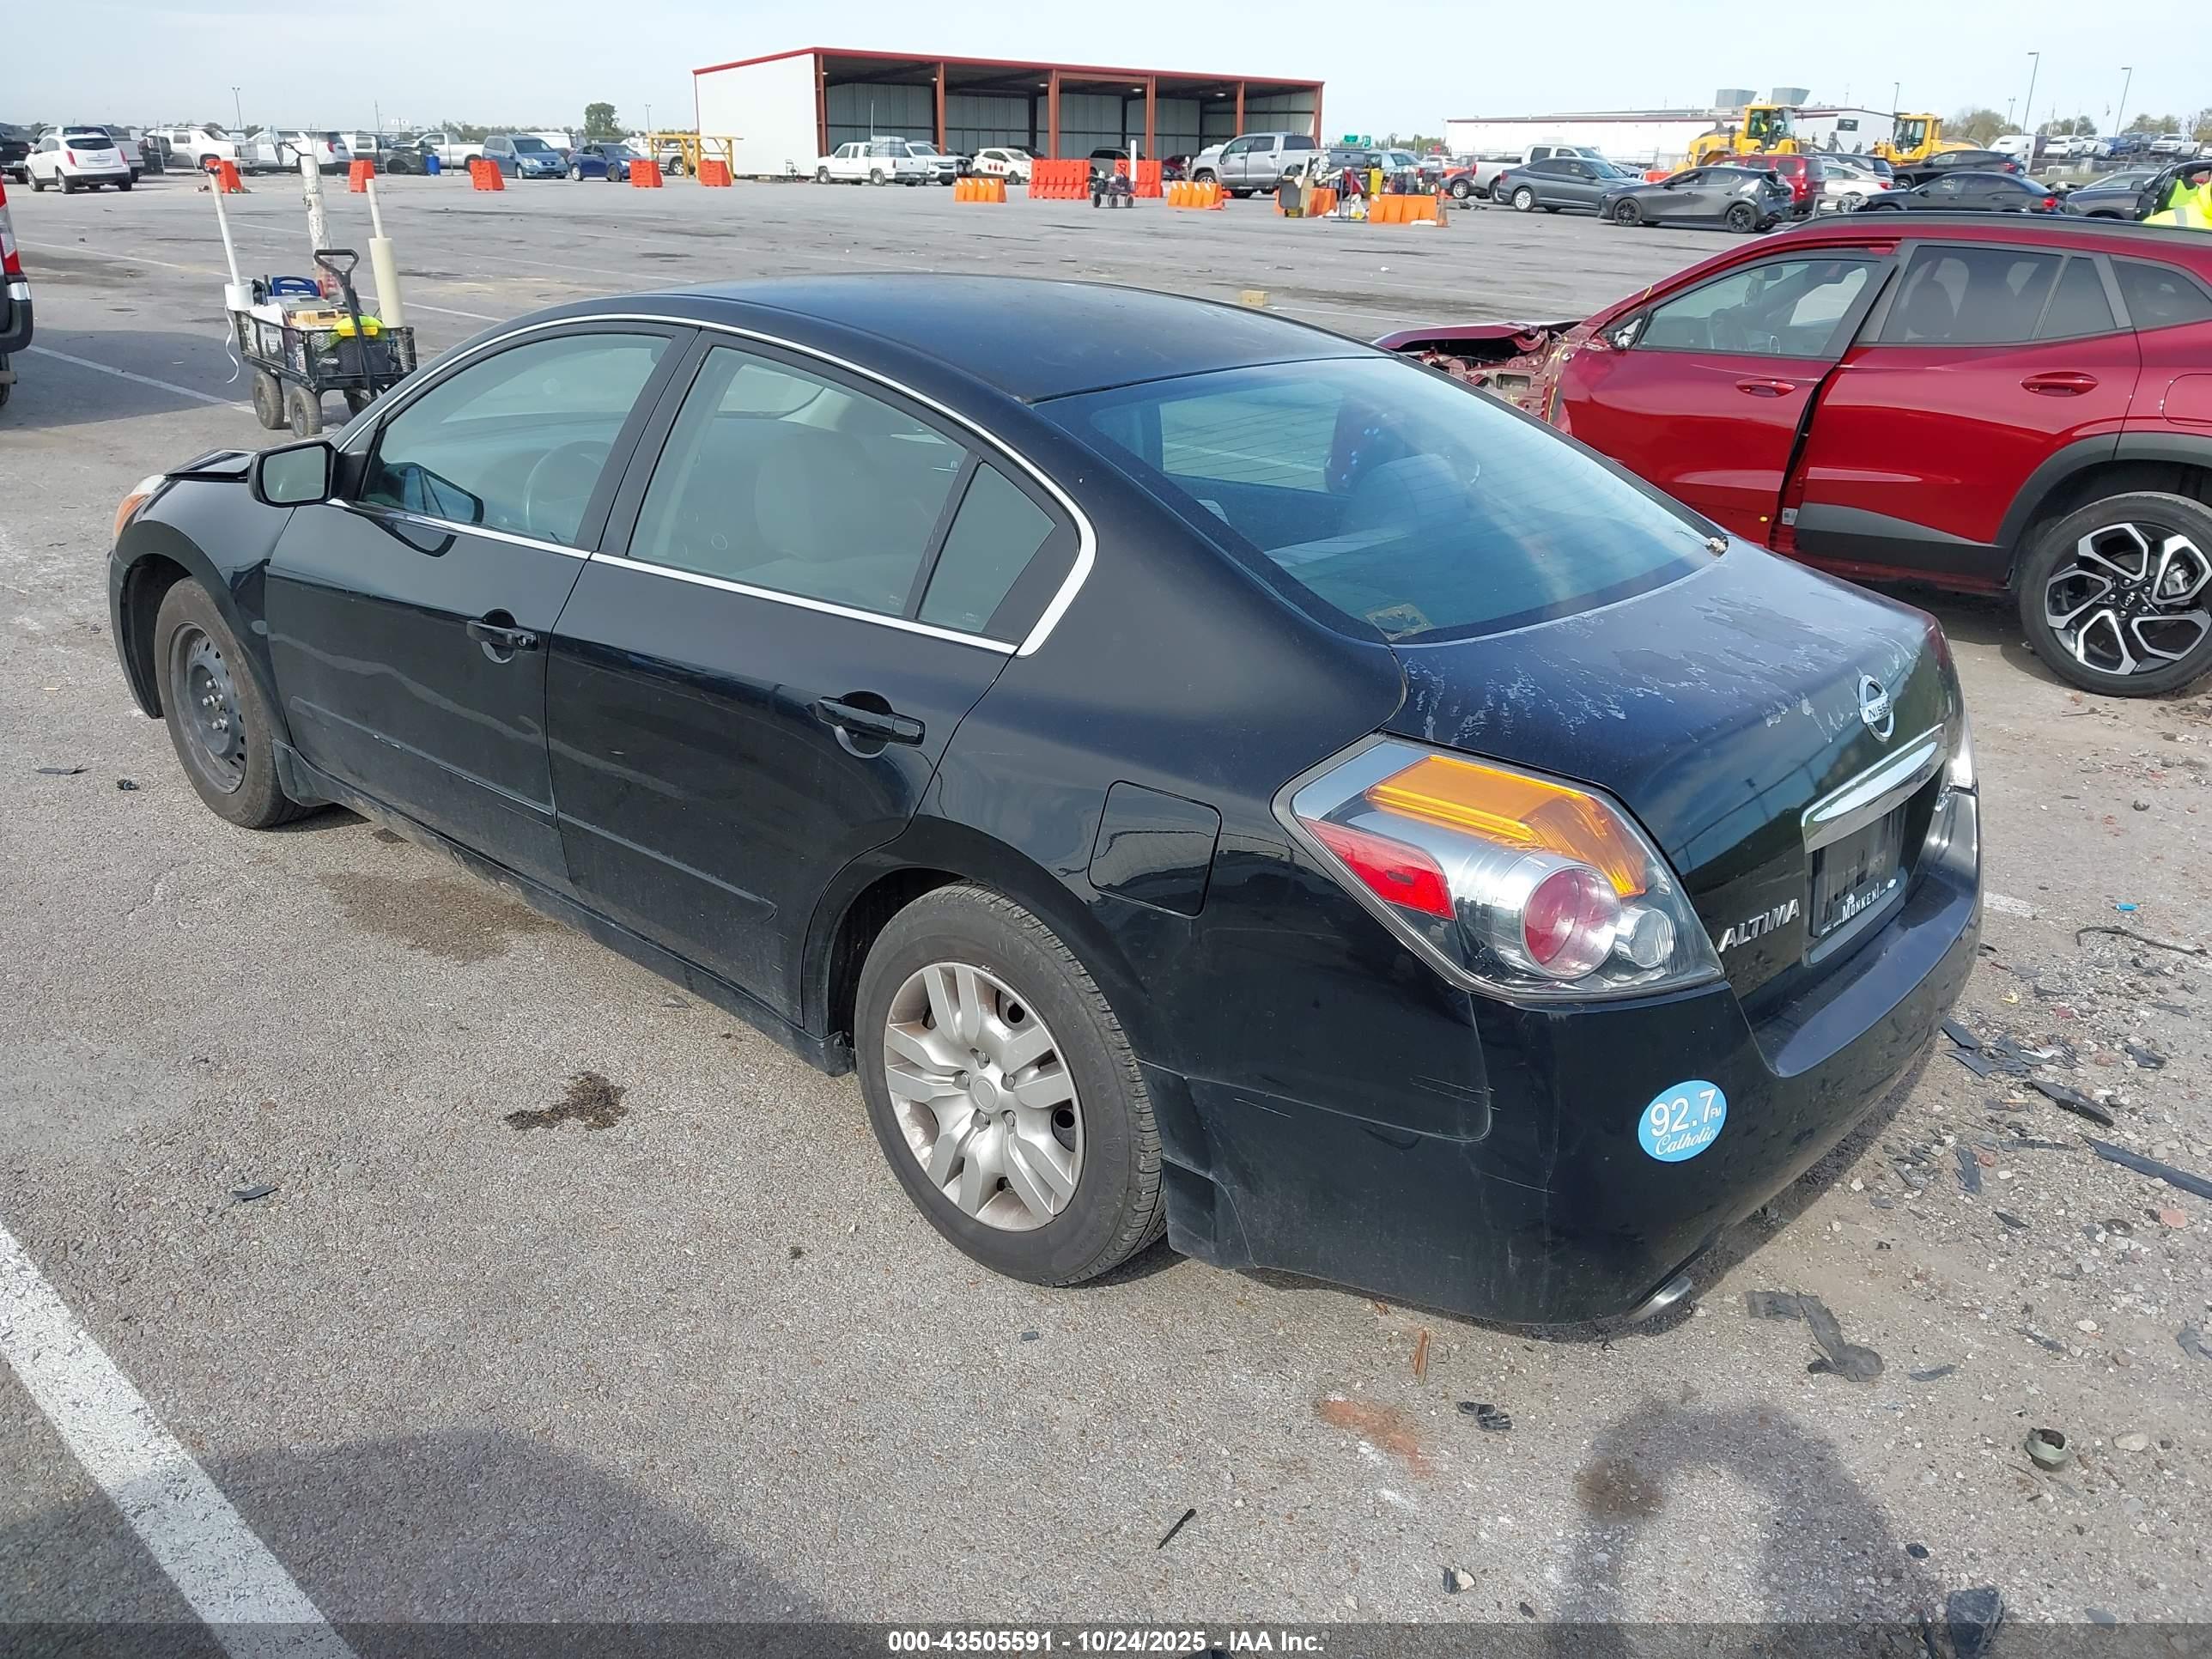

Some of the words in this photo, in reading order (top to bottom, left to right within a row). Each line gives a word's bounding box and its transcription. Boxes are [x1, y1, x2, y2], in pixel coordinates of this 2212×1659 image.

[1717, 898, 1800, 953] ALTIMA
[1650, 1088, 1717, 1137] 92.7
[1655, 1127, 1717, 1156] Catholic
